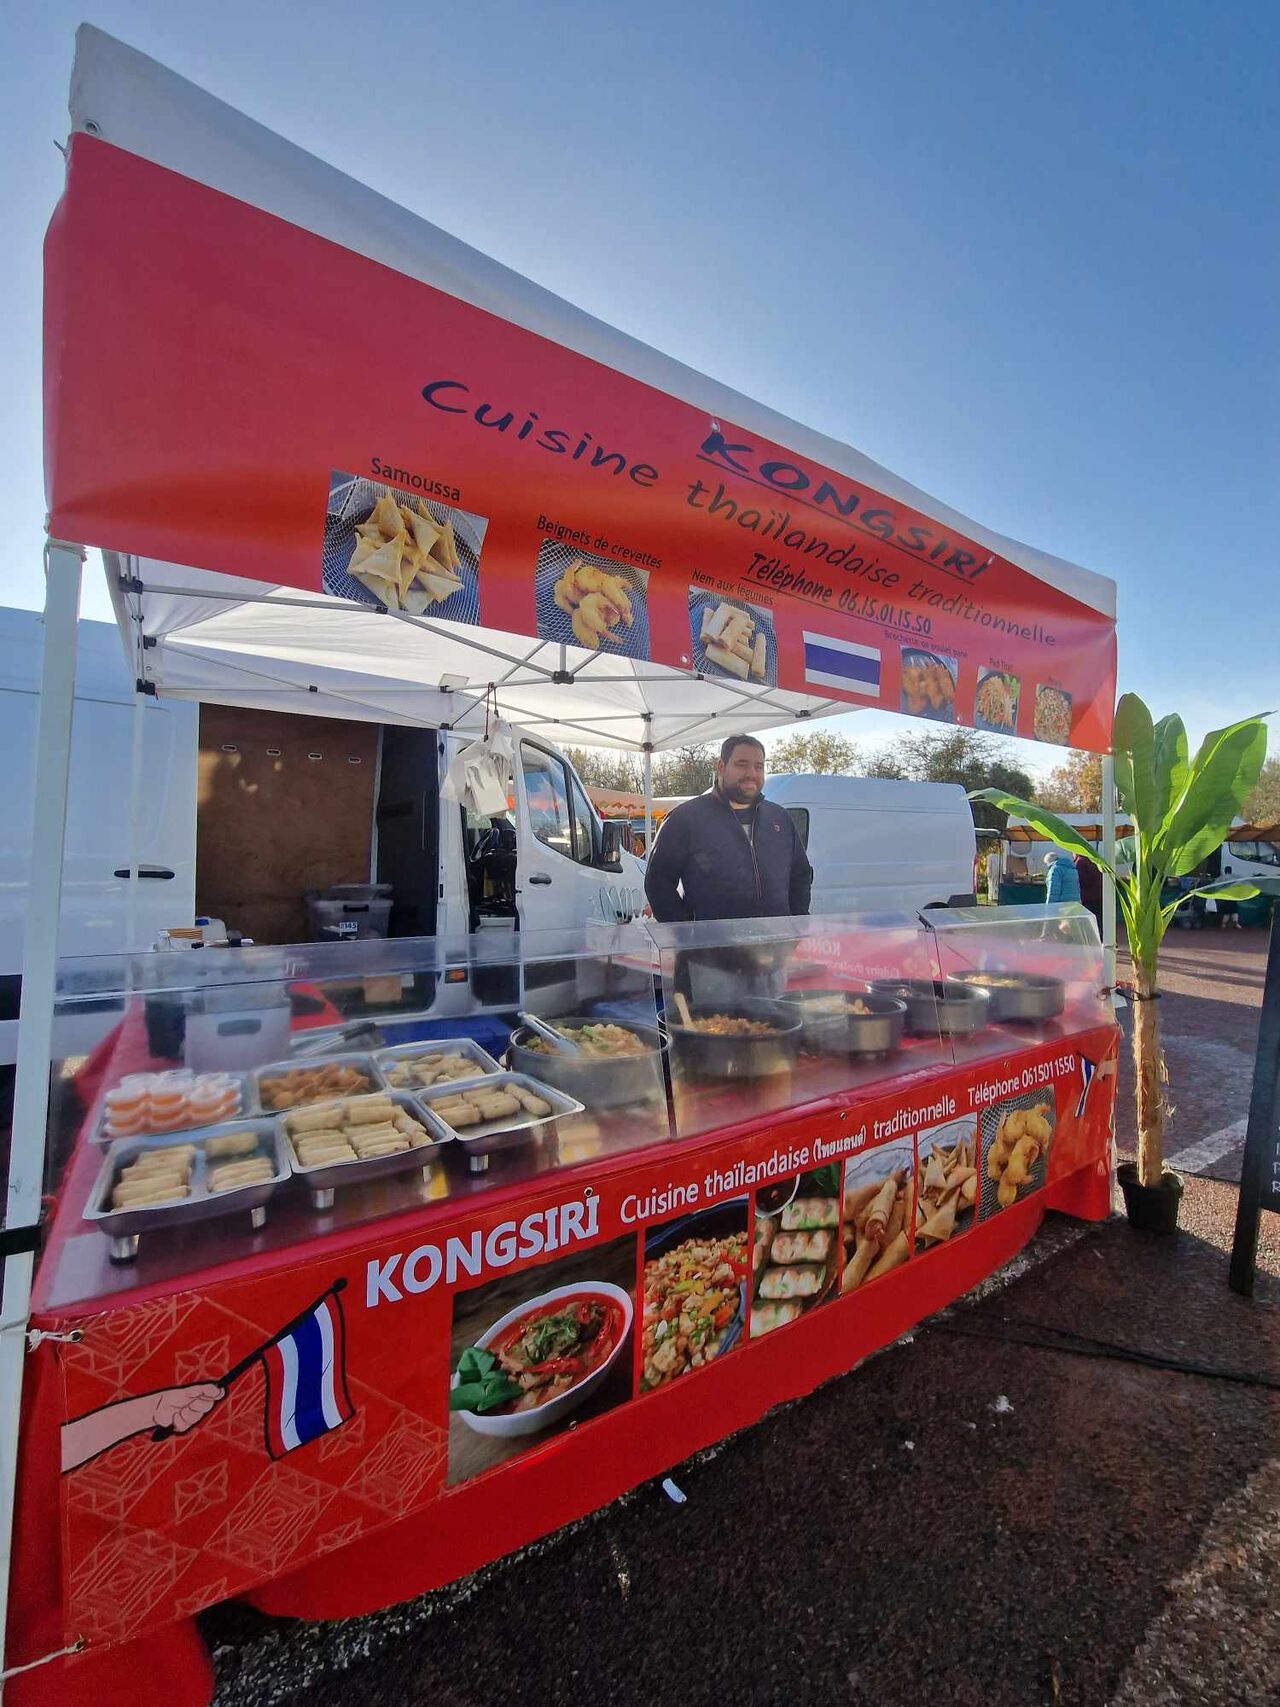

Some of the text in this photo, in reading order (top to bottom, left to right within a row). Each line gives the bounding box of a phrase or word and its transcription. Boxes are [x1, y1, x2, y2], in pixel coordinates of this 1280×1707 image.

[371, 457, 461, 502] Samoussa
[421, 380, 1056, 646] Cuisine thaïlandaise traditionnelle
[700, 431, 990, 579] KONGSIRI
[537, 515, 663, 569] Beignets de crevettes
[692, 568, 714, 586] Nem
[717, 579, 735, 592] aux
[746, 552, 932, 635] Téléphone 06.15.01.15.50
[968, 1054, 1075, 1106] Téléphone 0615011550
[620, 1182, 698, 1223] Cuisine
[704, 1146, 809, 1197] thaïlandaise
[874, 1096, 956, 1138] traditionnelle
[366, 1194, 601, 1309] KONGSIRI
